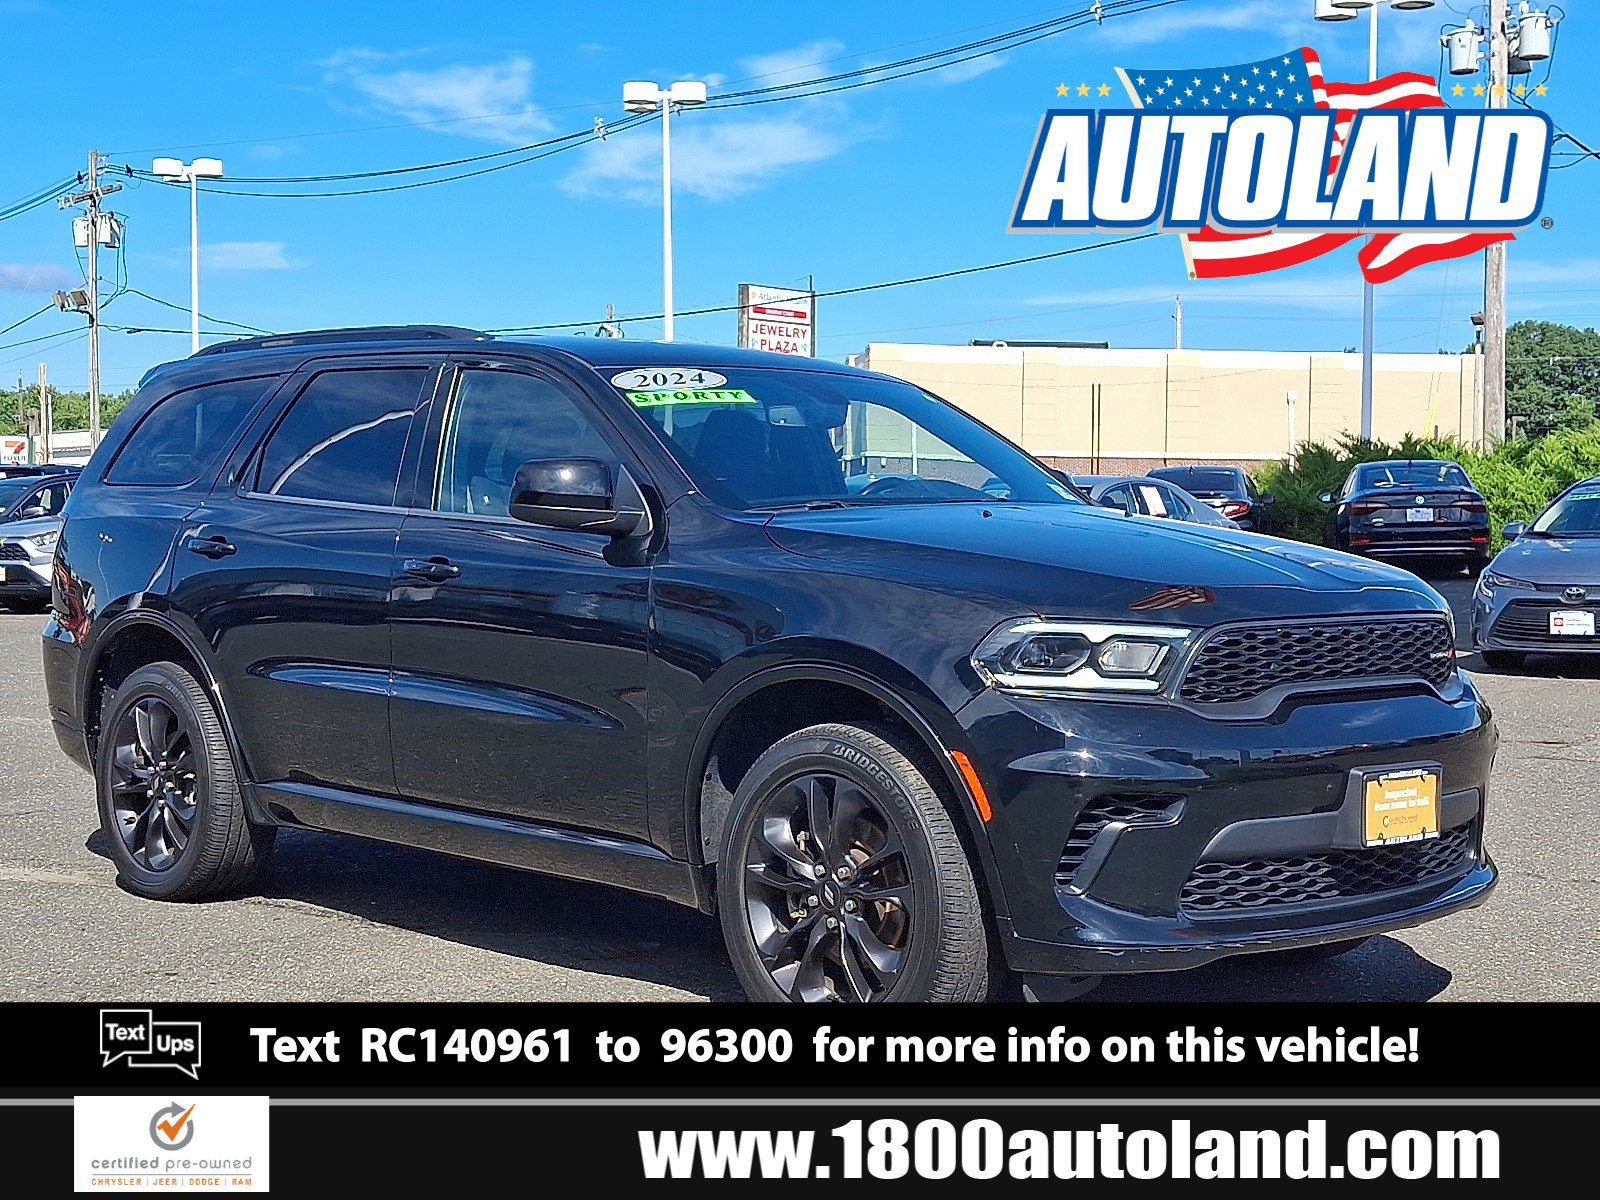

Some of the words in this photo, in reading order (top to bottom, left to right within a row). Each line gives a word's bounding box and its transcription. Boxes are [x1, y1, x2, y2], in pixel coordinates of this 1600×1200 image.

[752, 323, 807, 339] JEWELRY
[760, 339, 798, 354] PLAZA
[634, 372, 706, 388] 2024
[634, 391, 743, 403] SPORTY
[832, 744, 920, 830] BRIDGESTONE
